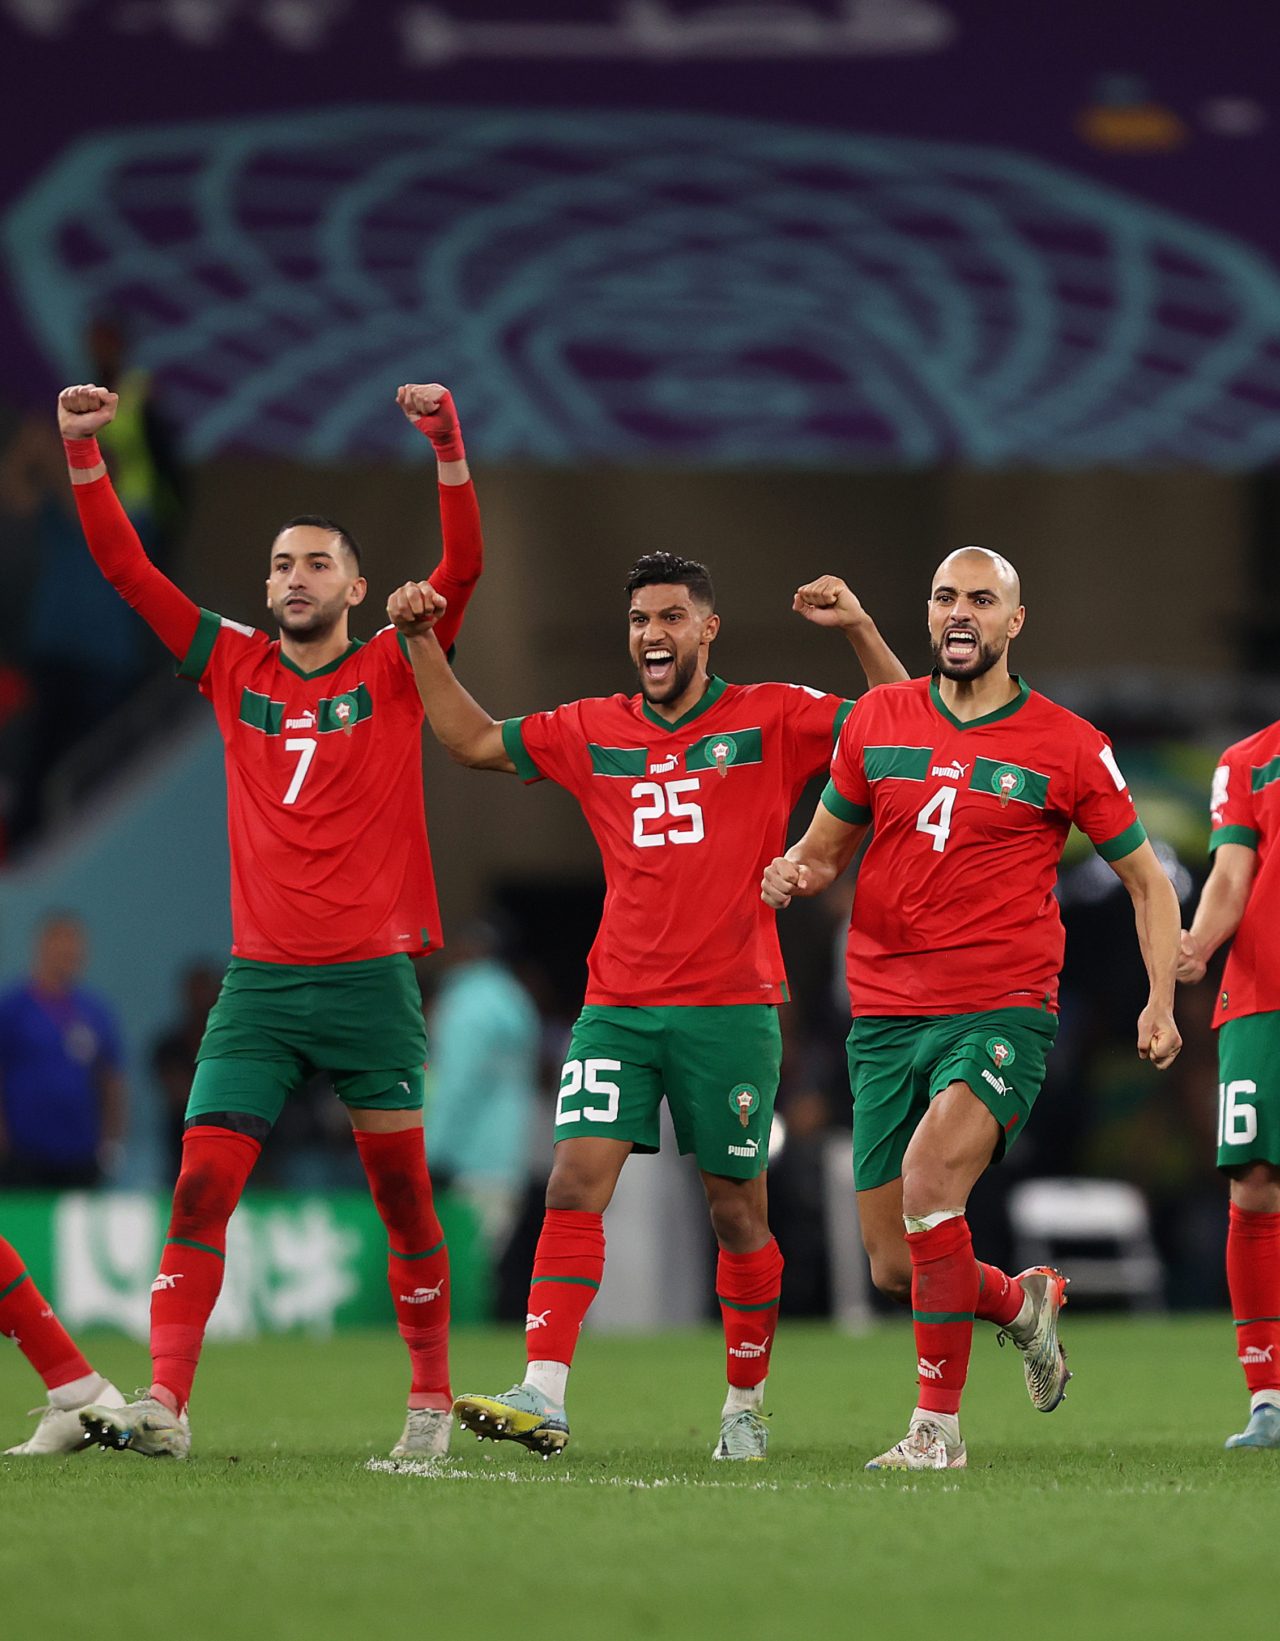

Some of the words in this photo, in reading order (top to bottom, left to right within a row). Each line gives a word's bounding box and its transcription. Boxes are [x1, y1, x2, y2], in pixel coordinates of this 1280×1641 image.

[285, 718, 312, 729] PUMA
[282, 738, 317, 805] 7
[650, 761, 674, 774] PUMA
[931, 766, 960, 780] PUMA
[631, 777, 705, 848] 25
[916, 786, 958, 854] 4
[555, 1058, 622, 1126] 25
[981, 1069, 1003, 1095] PUMA
[1219, 1079, 1257, 1147] 16
[728, 1145, 755, 1157] PUMA
[400, 1294, 434, 1304] PUMA
[729, 1347, 760, 1358] PUMA
